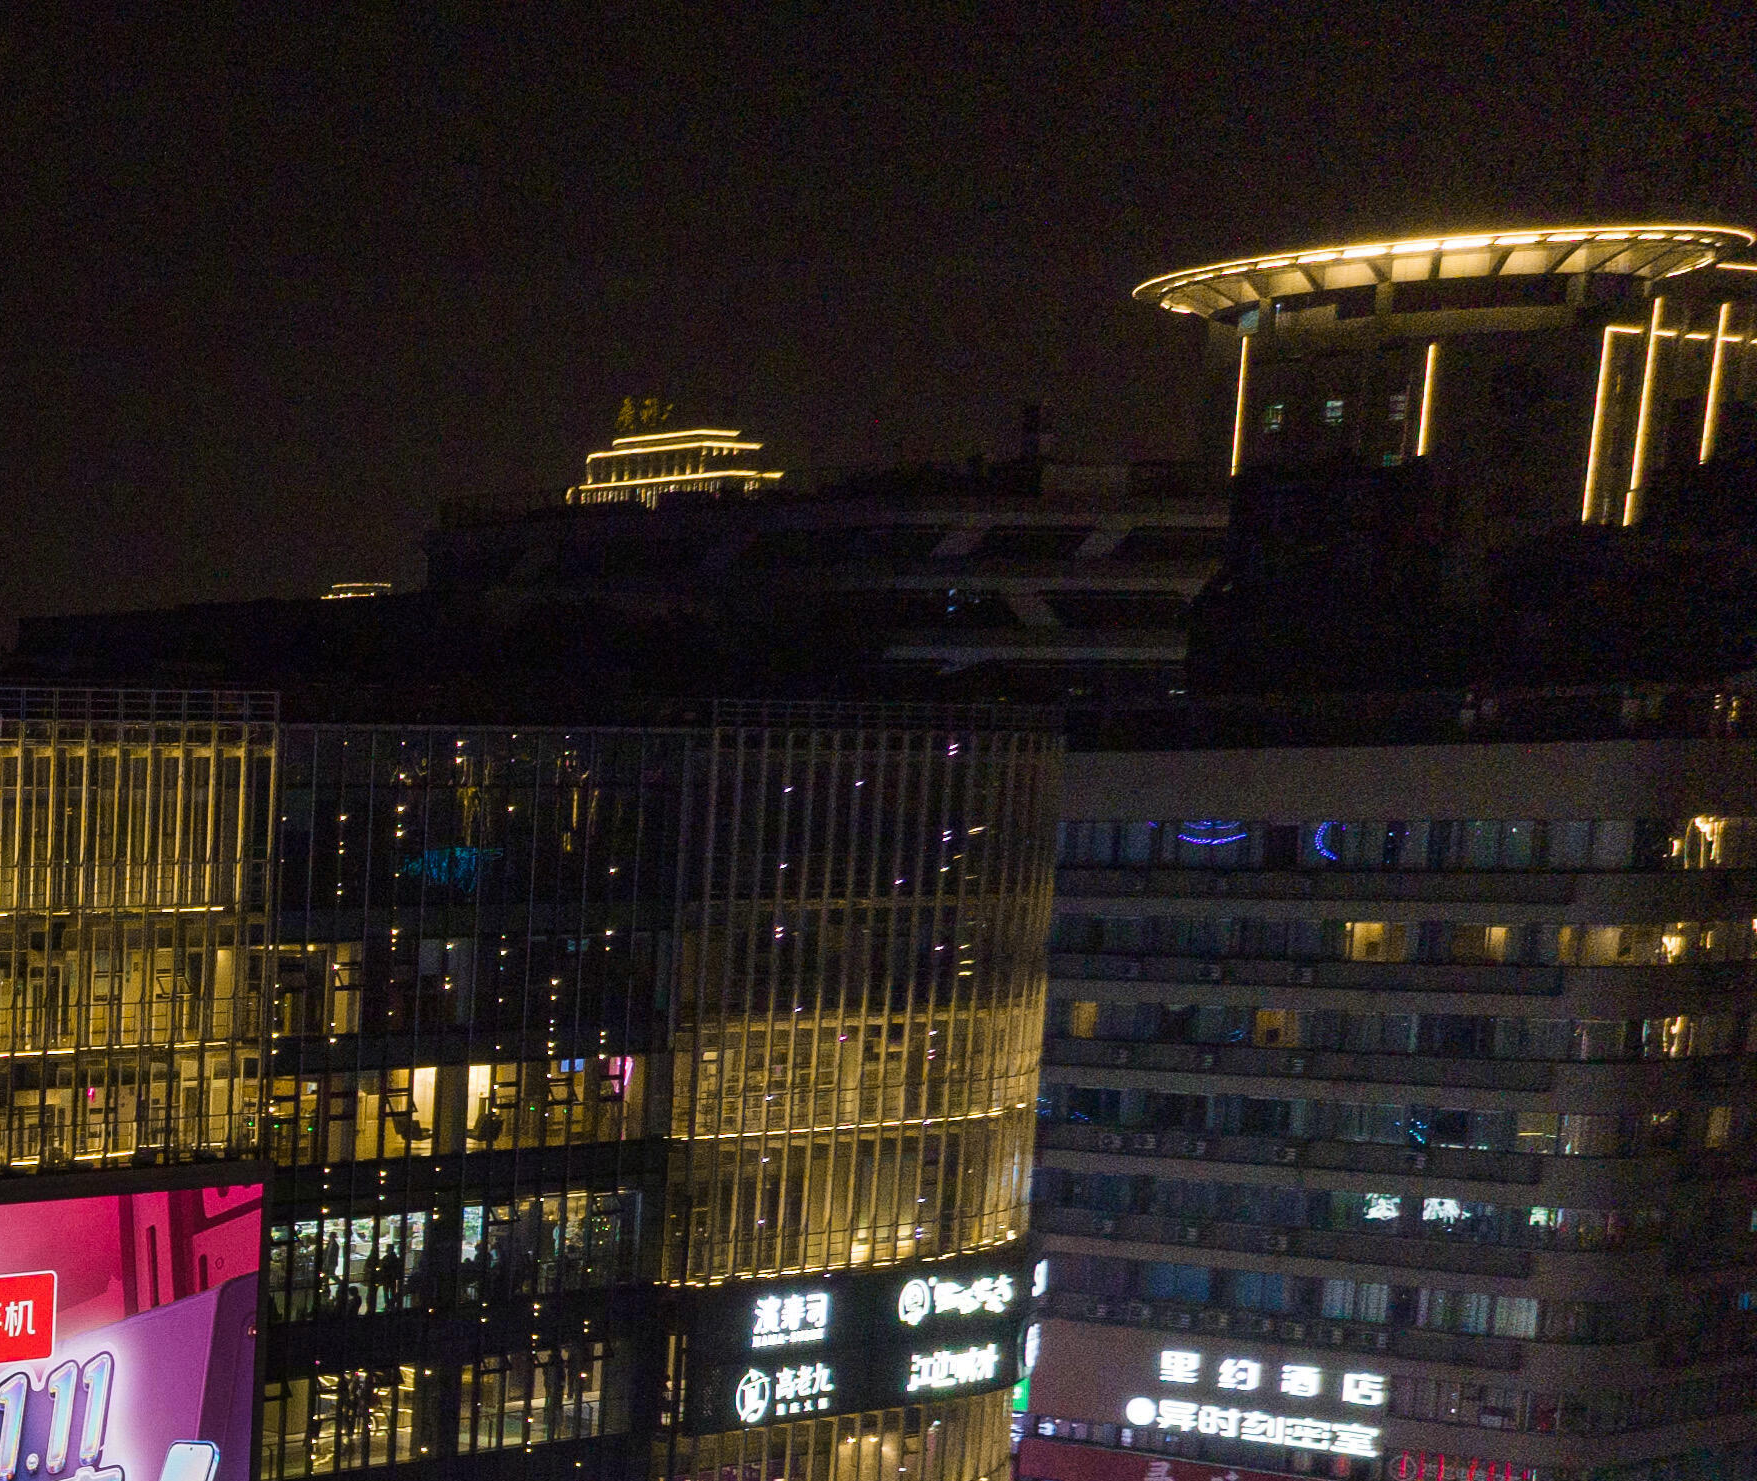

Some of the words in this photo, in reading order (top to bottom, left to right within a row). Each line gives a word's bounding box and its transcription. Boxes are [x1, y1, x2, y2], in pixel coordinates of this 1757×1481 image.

[775, 1362, 835, 1401] 高老九
[1158, 1349, 1385, 1407] 里约酒店
